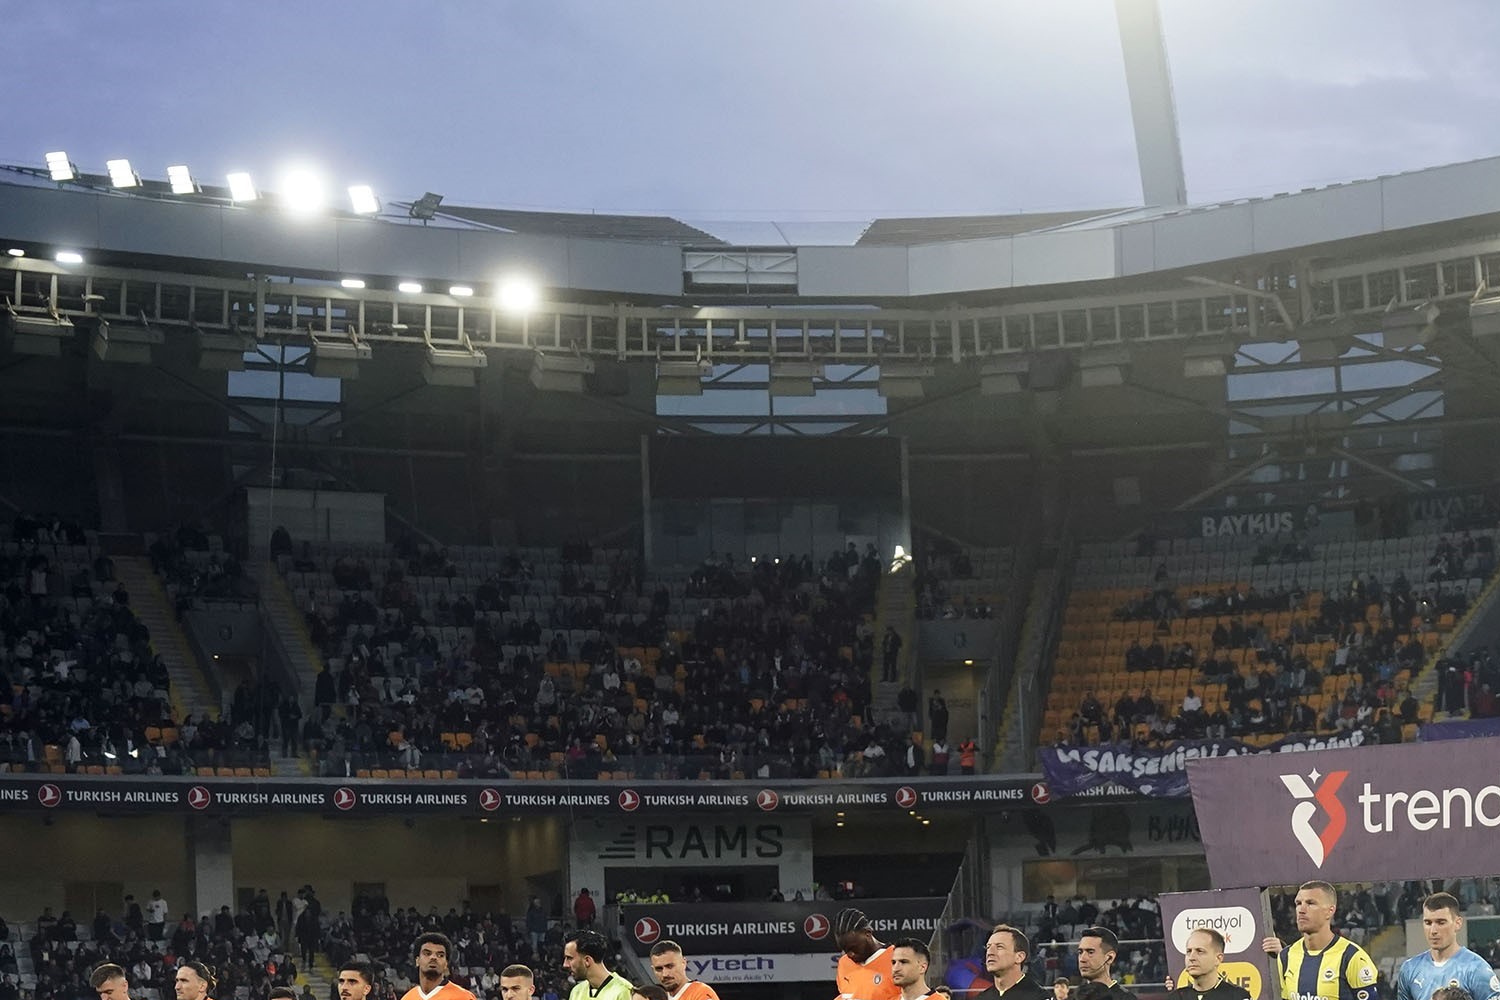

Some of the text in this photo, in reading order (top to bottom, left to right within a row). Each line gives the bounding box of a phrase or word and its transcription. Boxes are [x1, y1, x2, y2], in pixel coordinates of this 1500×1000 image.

[66, 790, 179, 803] TURKISH AIRLINES
[215, 792, 325, 804] TURKISH AIRLINES
[360, 793, 468, 805] TURKISH AIRLINES
[505, 795, 610, 806] TURKISH AIRLINES
[644, 795, 749, 806] TURKISH AIRLINES
[782, 792, 888, 806] TURKISH AIRLINES
[920, 788, 1024, 802] TURKISH AIRLINES
[644, 824, 784, 859] RAMS
[666, 921, 796, 936] TURKISH AIRLINES
[1186, 914, 1242, 931] trendyol
